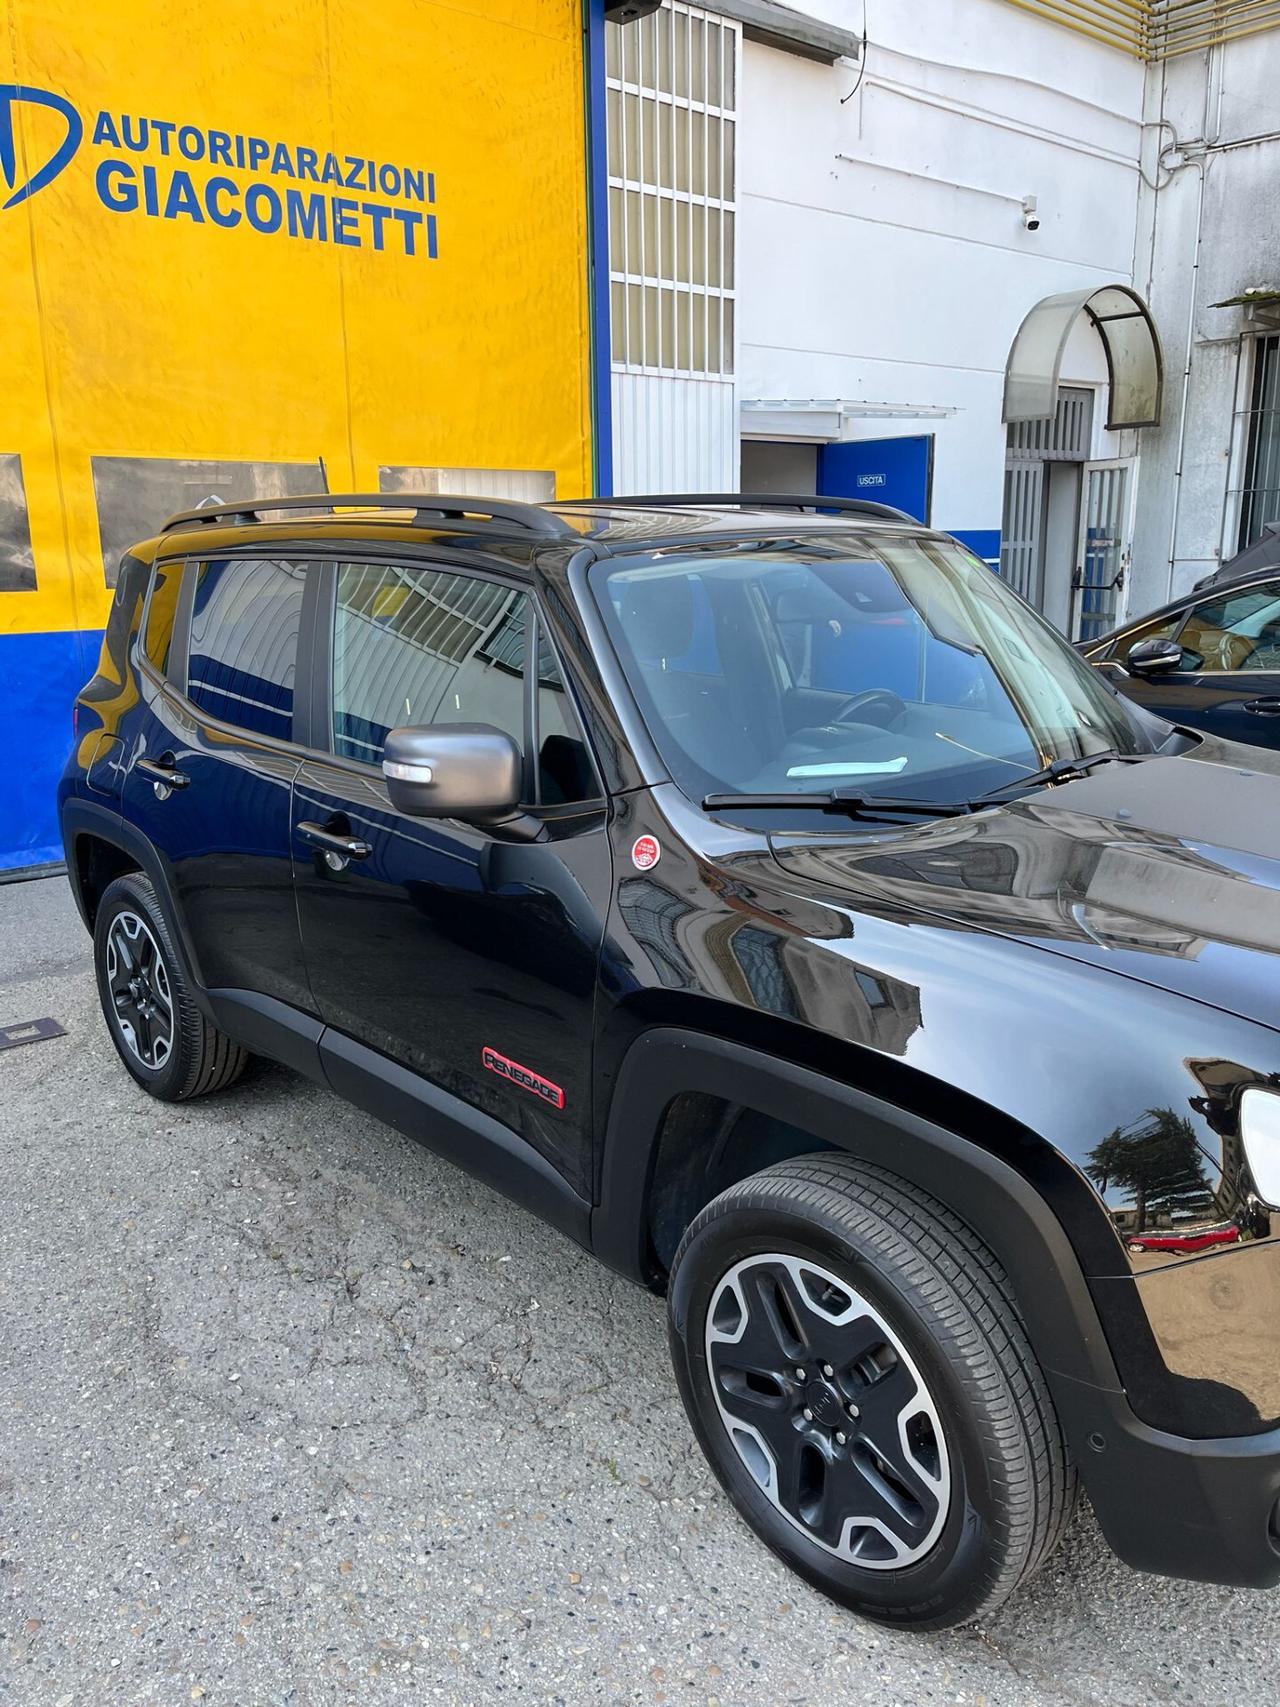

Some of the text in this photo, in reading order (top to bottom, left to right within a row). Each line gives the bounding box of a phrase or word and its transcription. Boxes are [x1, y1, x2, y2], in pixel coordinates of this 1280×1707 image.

[92, 111, 436, 204] AUTORIPARAZIONI
[95, 159, 439, 260] GIACOMETTI
[859, 476, 884, 485] USCITA
[484, 1052, 560, 1105] RENEGADE
